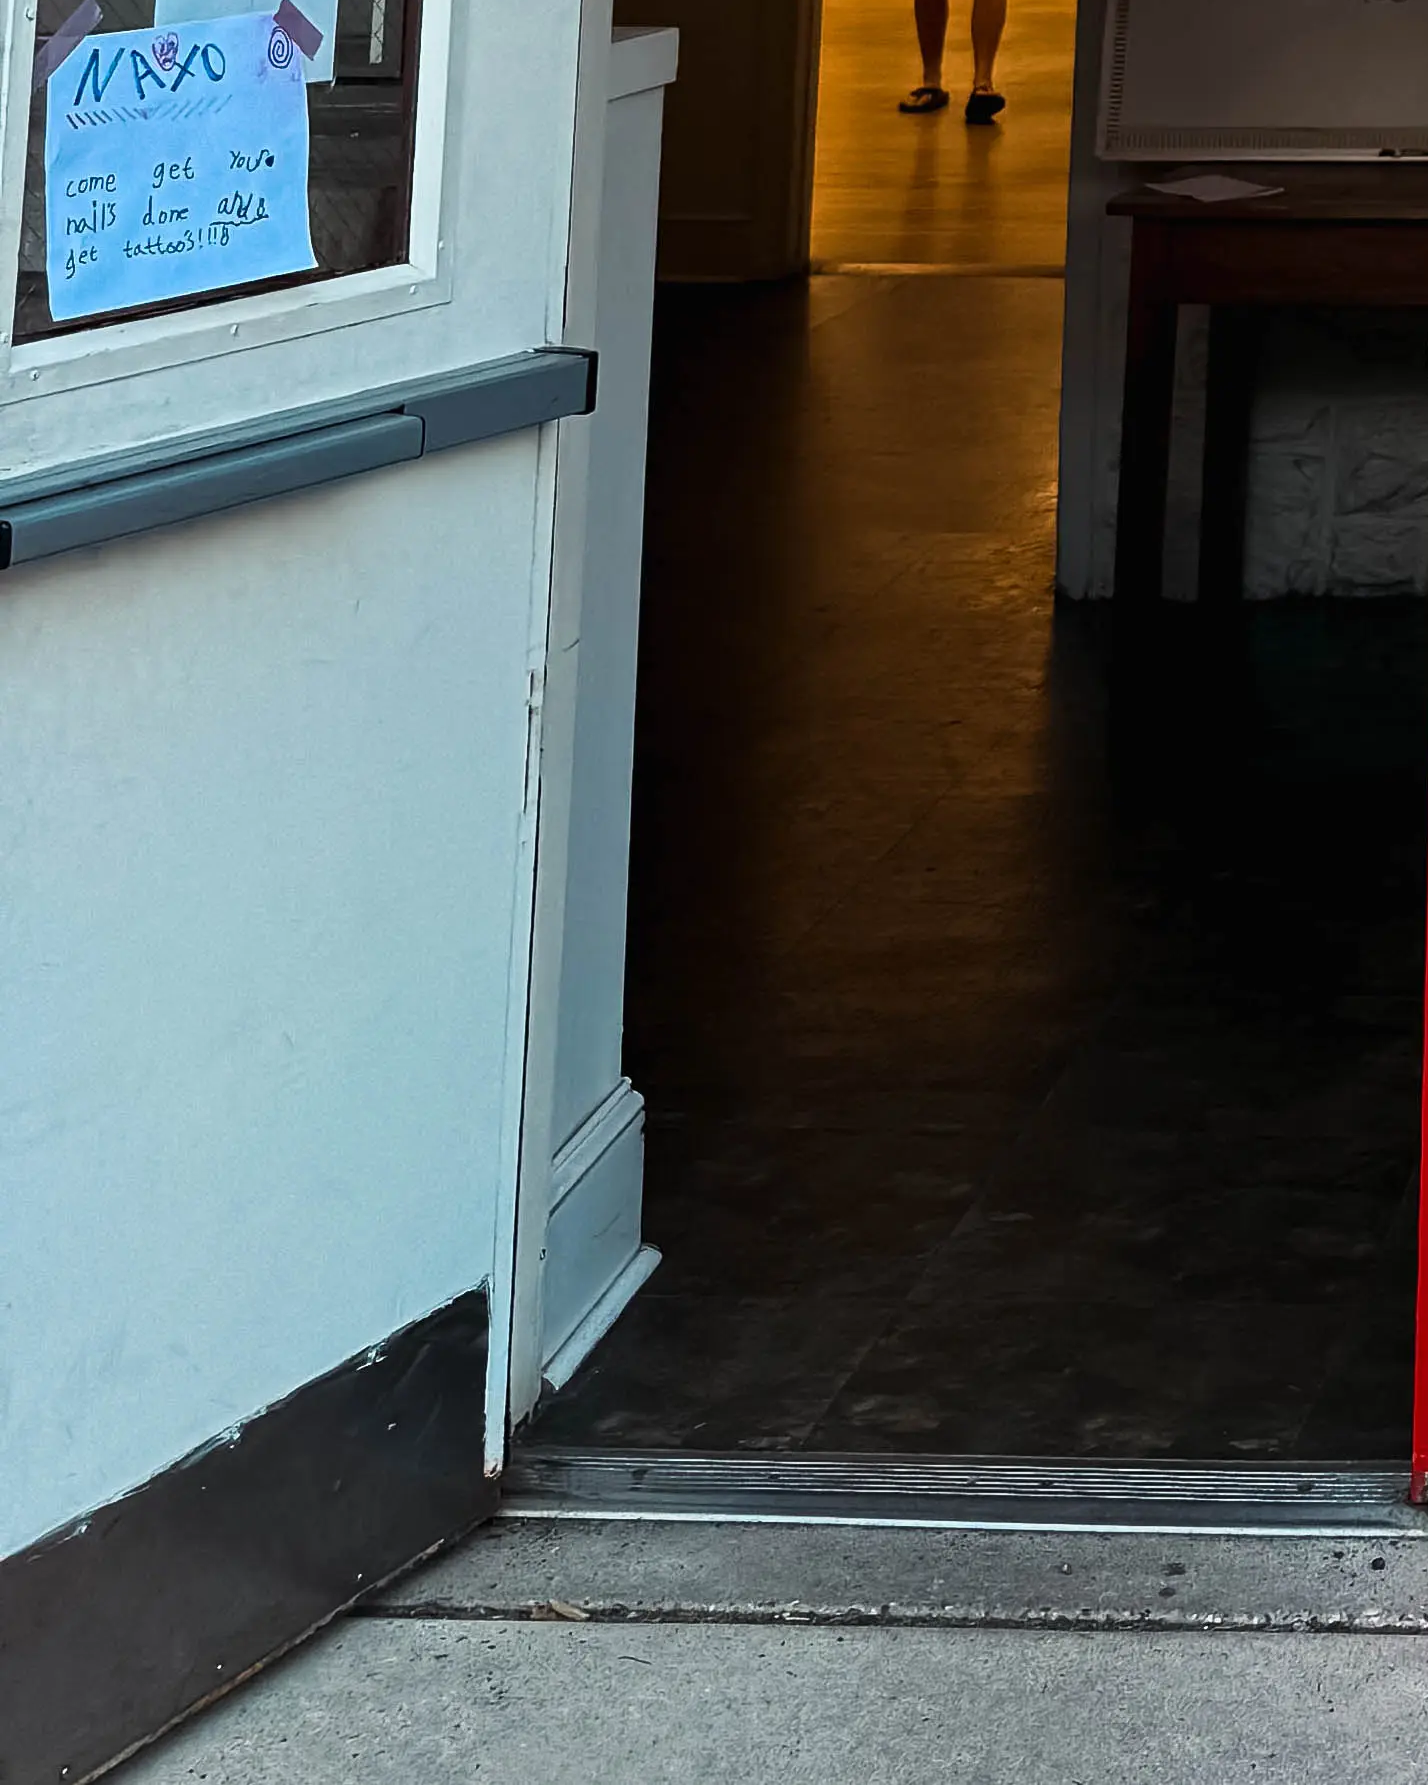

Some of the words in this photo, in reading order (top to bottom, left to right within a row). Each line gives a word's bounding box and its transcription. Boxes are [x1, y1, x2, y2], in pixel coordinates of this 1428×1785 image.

[66, 174, 117, 197] come
[152, 157, 195, 189] get
[142, 195, 189, 226] done
[66, 246, 98, 279] get
